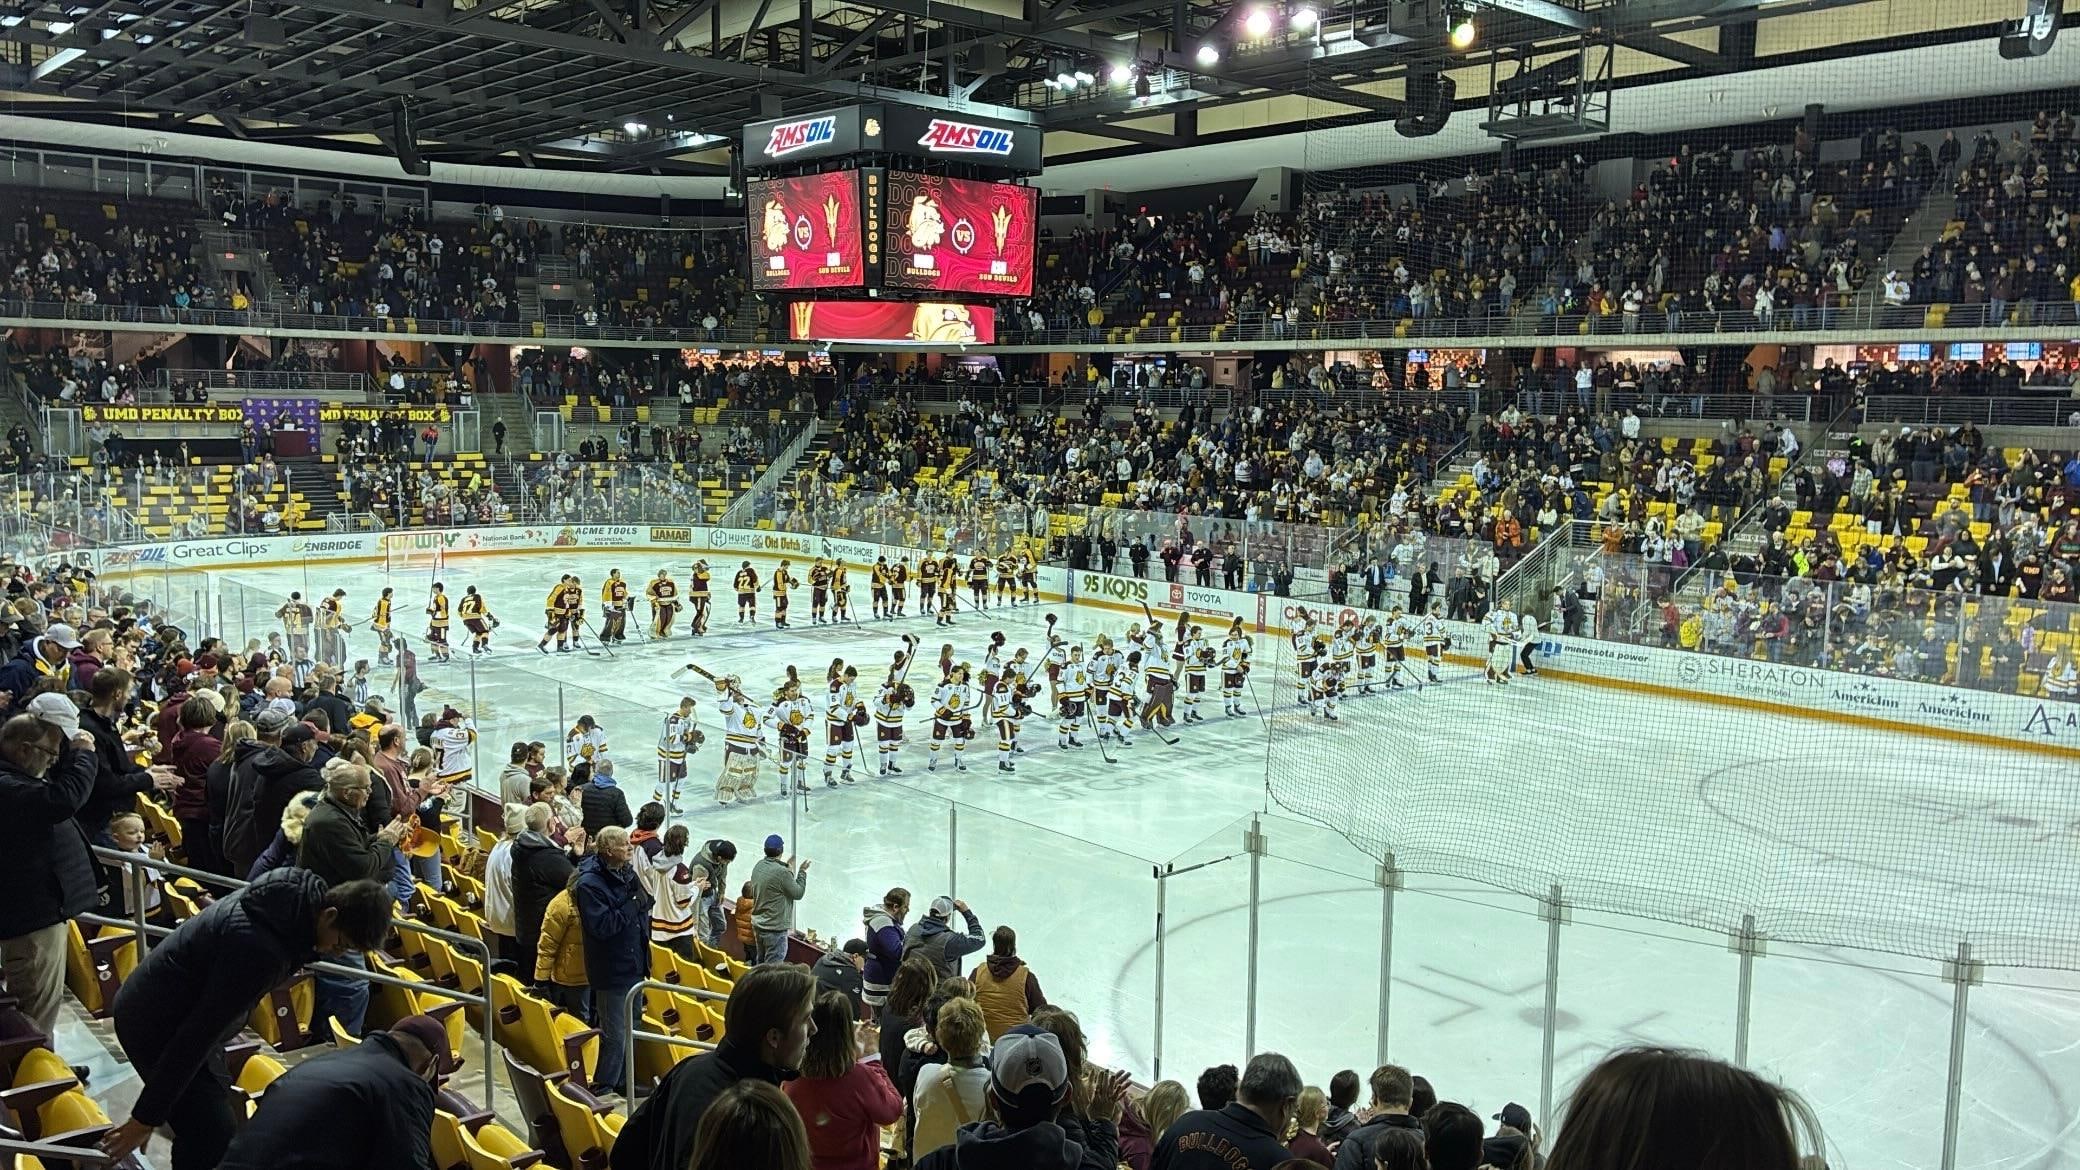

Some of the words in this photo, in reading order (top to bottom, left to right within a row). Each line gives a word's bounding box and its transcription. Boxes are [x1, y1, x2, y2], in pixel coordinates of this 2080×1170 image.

[767, 117, 834, 154] AMSOIL
[922, 120, 1012, 153] AMSOIL
[867, 174, 878, 264] BULLDOGS
[797, 226, 809, 239] VS
[955, 229, 971, 243] VS
[906, 267, 941, 277] BULLDOGS
[103, 407, 138, 421] UMD
[142, 408, 215, 421] PENALTY
[320, 410, 341, 421] MD
[408, 410, 435, 421] BOX
[575, 526, 604, 535] ACME
[607, 526, 637, 535] TOOLS
[652, 528, 690, 541] JAMAR
[728, 533, 750, 543] HUNT
[765, 535, 779, 549] Old
[173, 544, 223, 558] Great
[226, 541, 268, 558] Clips
[304, 540, 363, 552] ENBRIDGE
[833, 544, 853, 556] NORTH
[854, 547, 873, 558] SHORE
[1083, 574, 1099, 593] 95
[1103, 577, 1148, 600] KQDS
[1187, 591, 1222, 605] TOYOTA
[1426, 622, 1433, 636] 3
[1564, 644, 1614, 658] minnesota
[1617, 650, 1649, 662] power
[1708, 659, 1824, 688] SHERATON
[1735, 683, 1763, 694] Duluth
[1767, 686, 1791, 698] Hotel
[1831, 688, 1899, 708] AmericInn
[1917, 702, 1990, 722] AmericInn
[1178, 1131, 1252, 1170] BULLDOG
